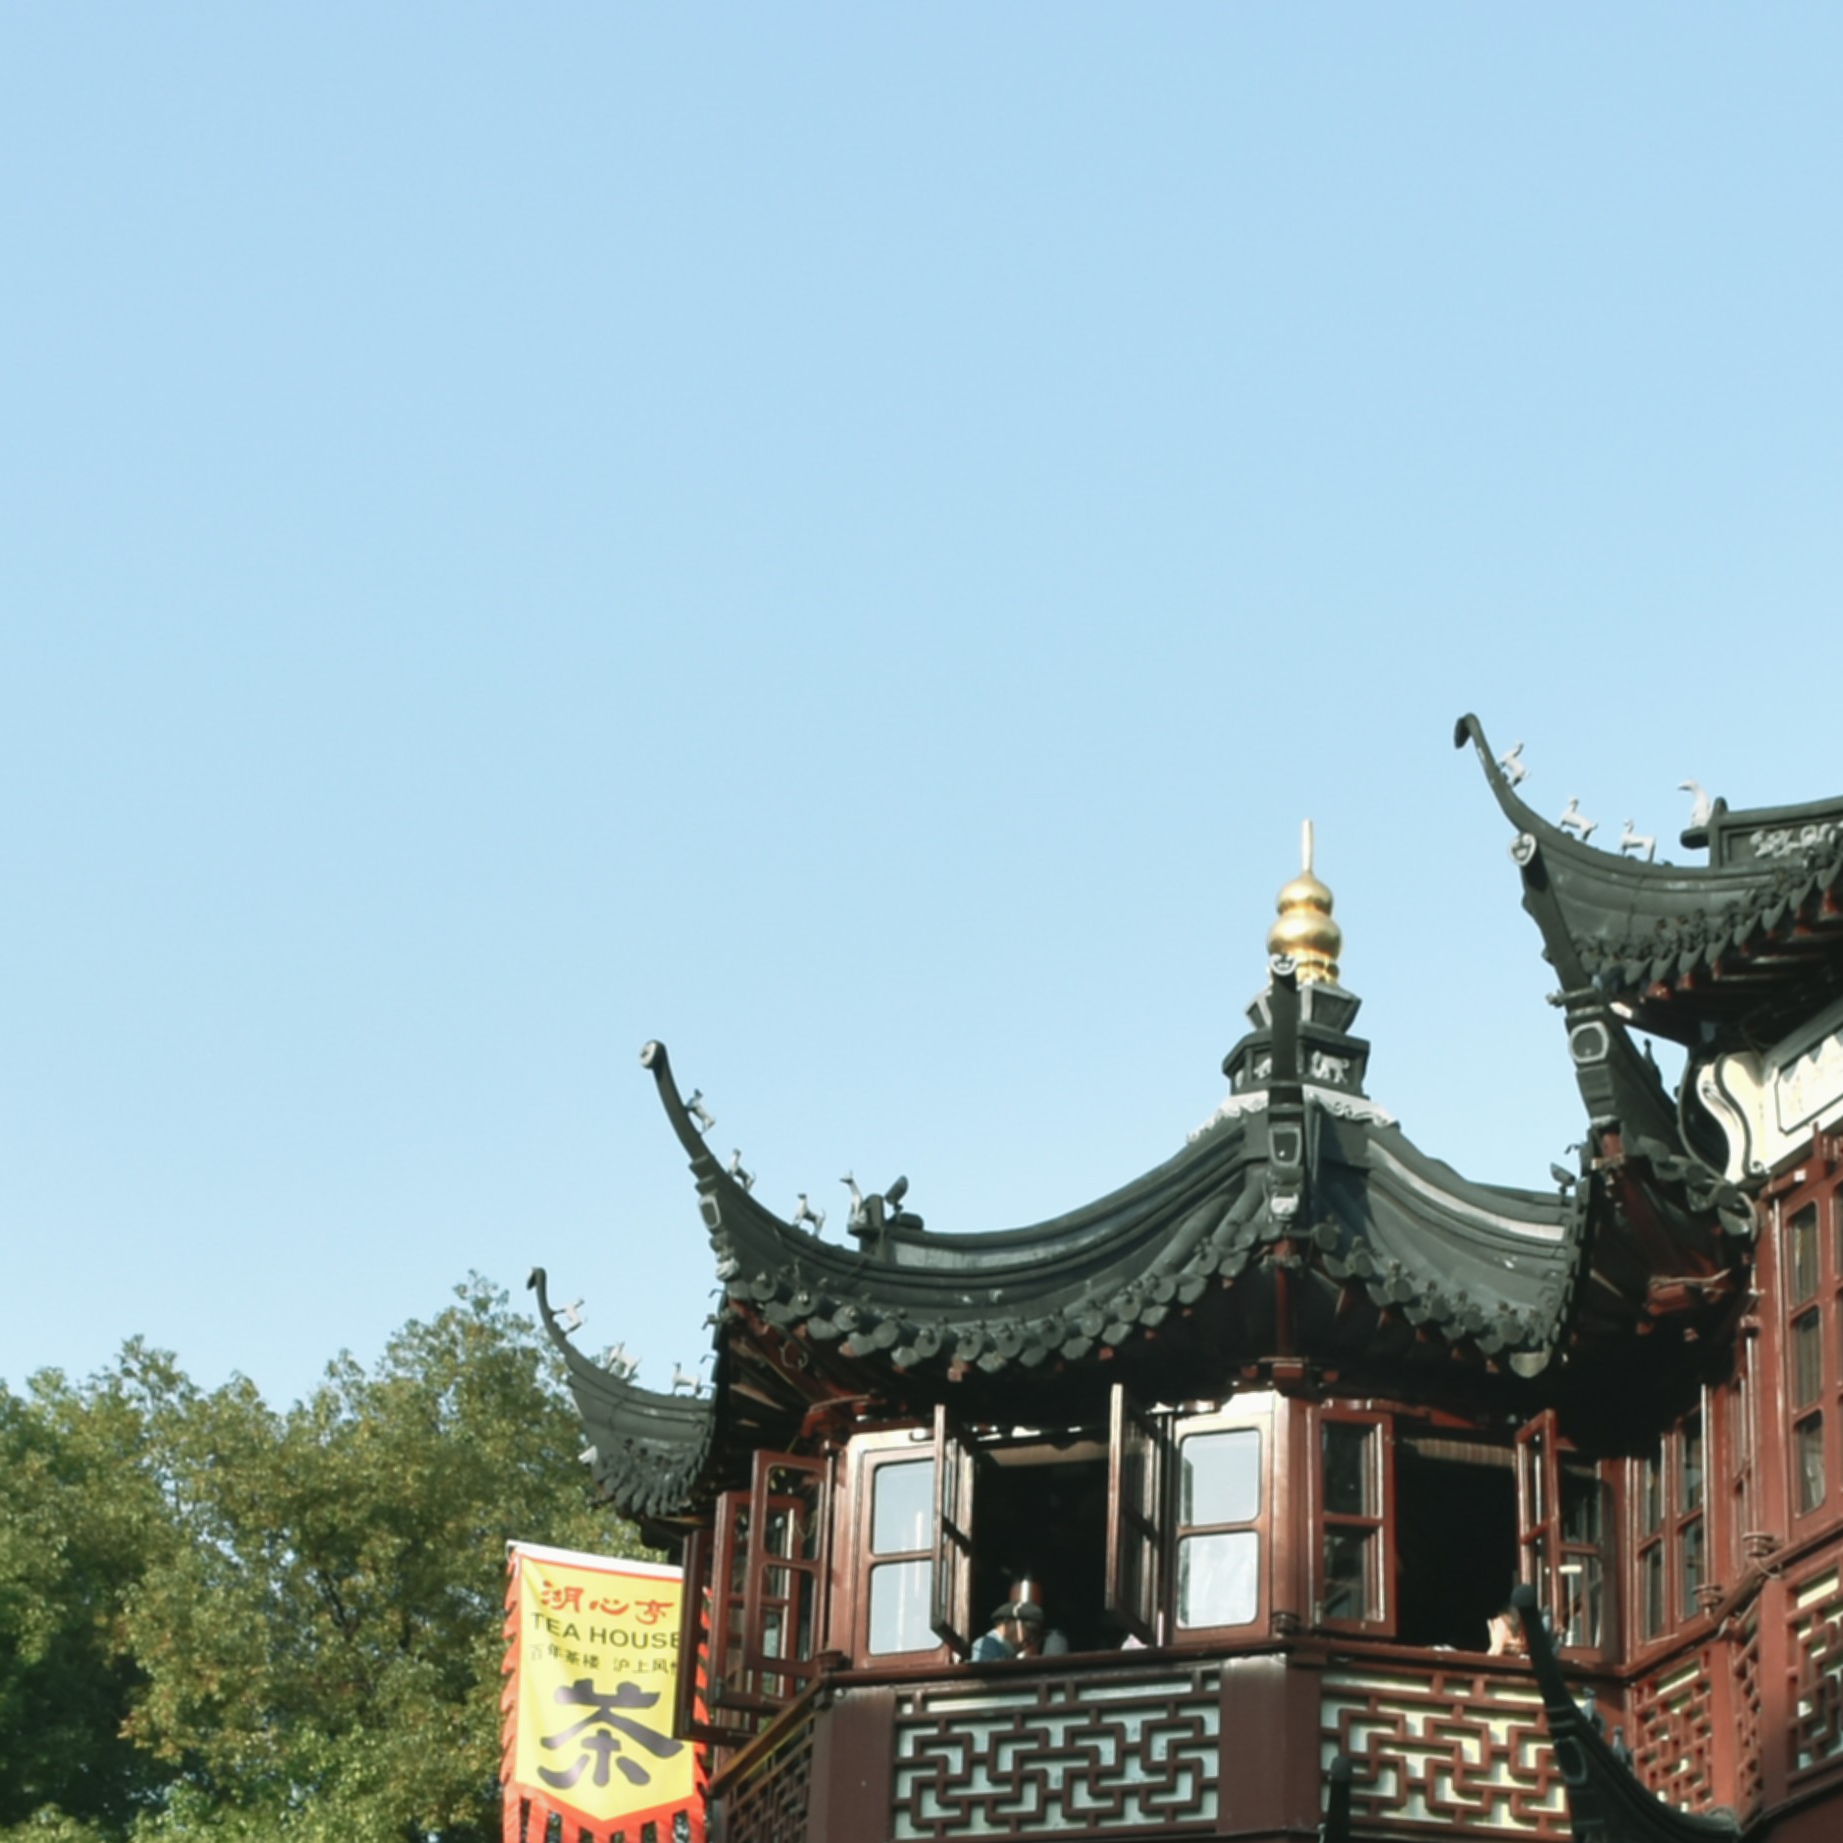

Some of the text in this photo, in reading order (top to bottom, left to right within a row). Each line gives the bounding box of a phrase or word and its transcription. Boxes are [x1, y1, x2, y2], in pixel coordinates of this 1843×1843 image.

[541, 1580, 675, 1626] 湖心亭
[530, 1611, 680, 1650] TEA HOUSE
[529, 1642, 601, 1670] 百年茶楼
[538, 1678, 685, 1789] 茶
